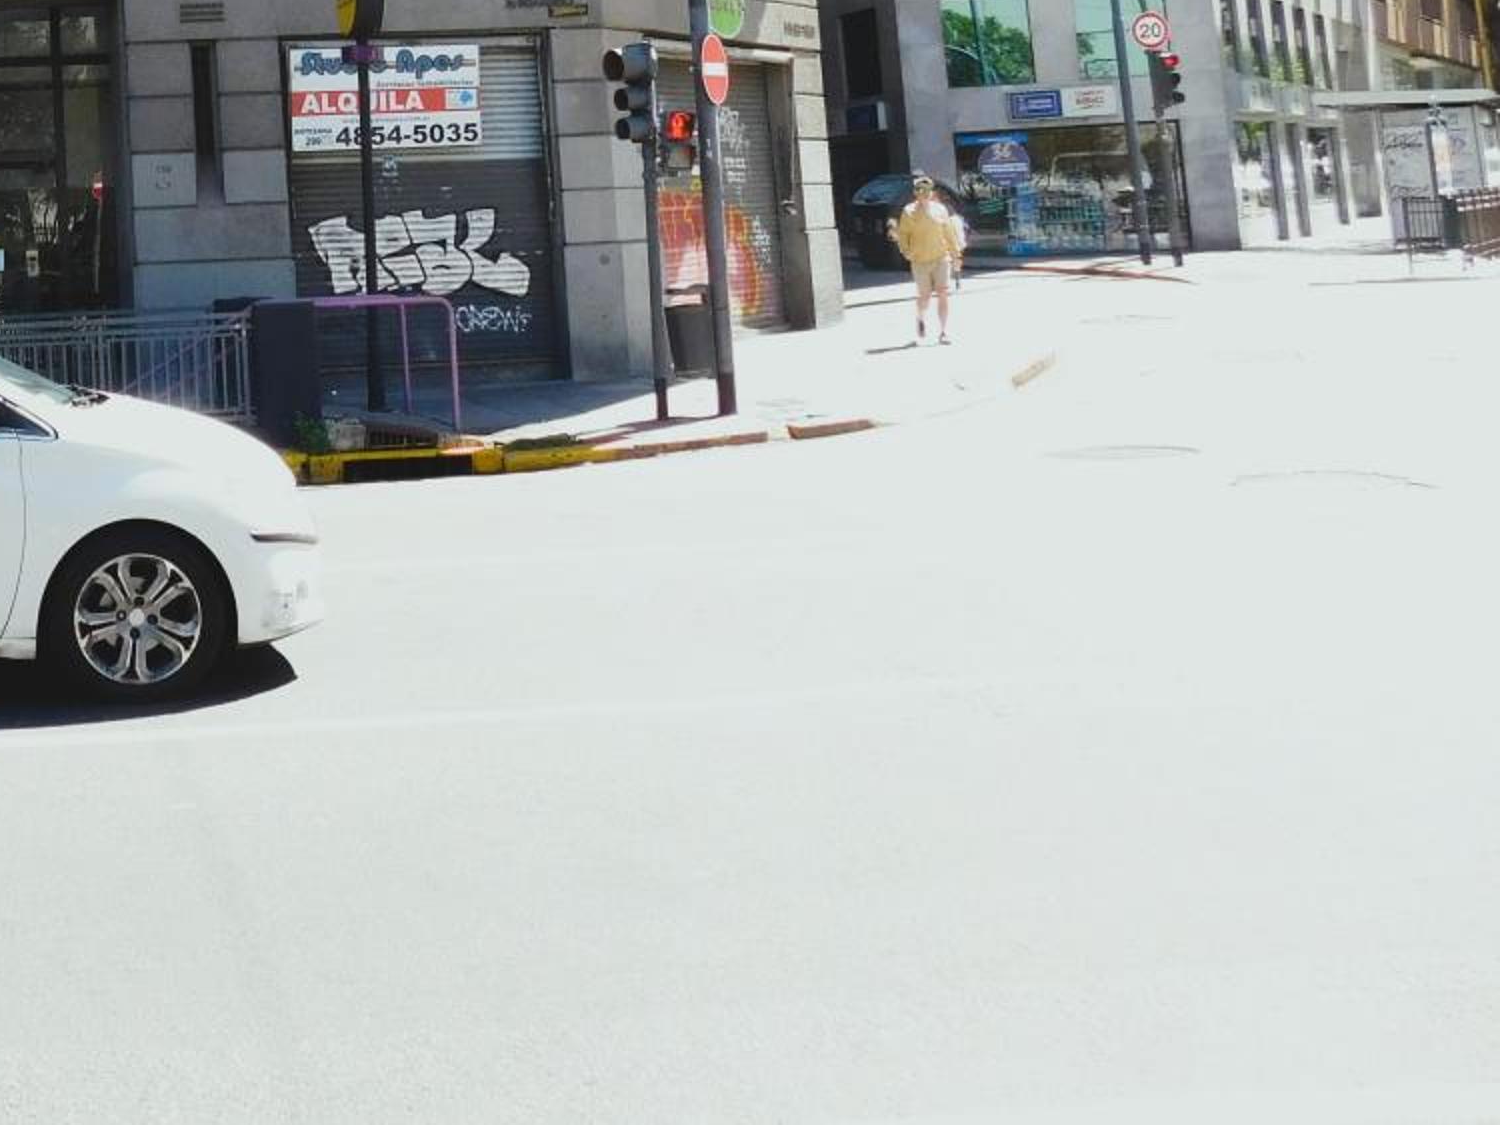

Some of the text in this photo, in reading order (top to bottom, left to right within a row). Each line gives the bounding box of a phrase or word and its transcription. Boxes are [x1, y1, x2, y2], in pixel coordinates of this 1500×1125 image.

[1140, 23, 1161, 38] 20
[301, 90, 425, 114] ALQILA
[336, 123, 478, 146] 4854-5035
